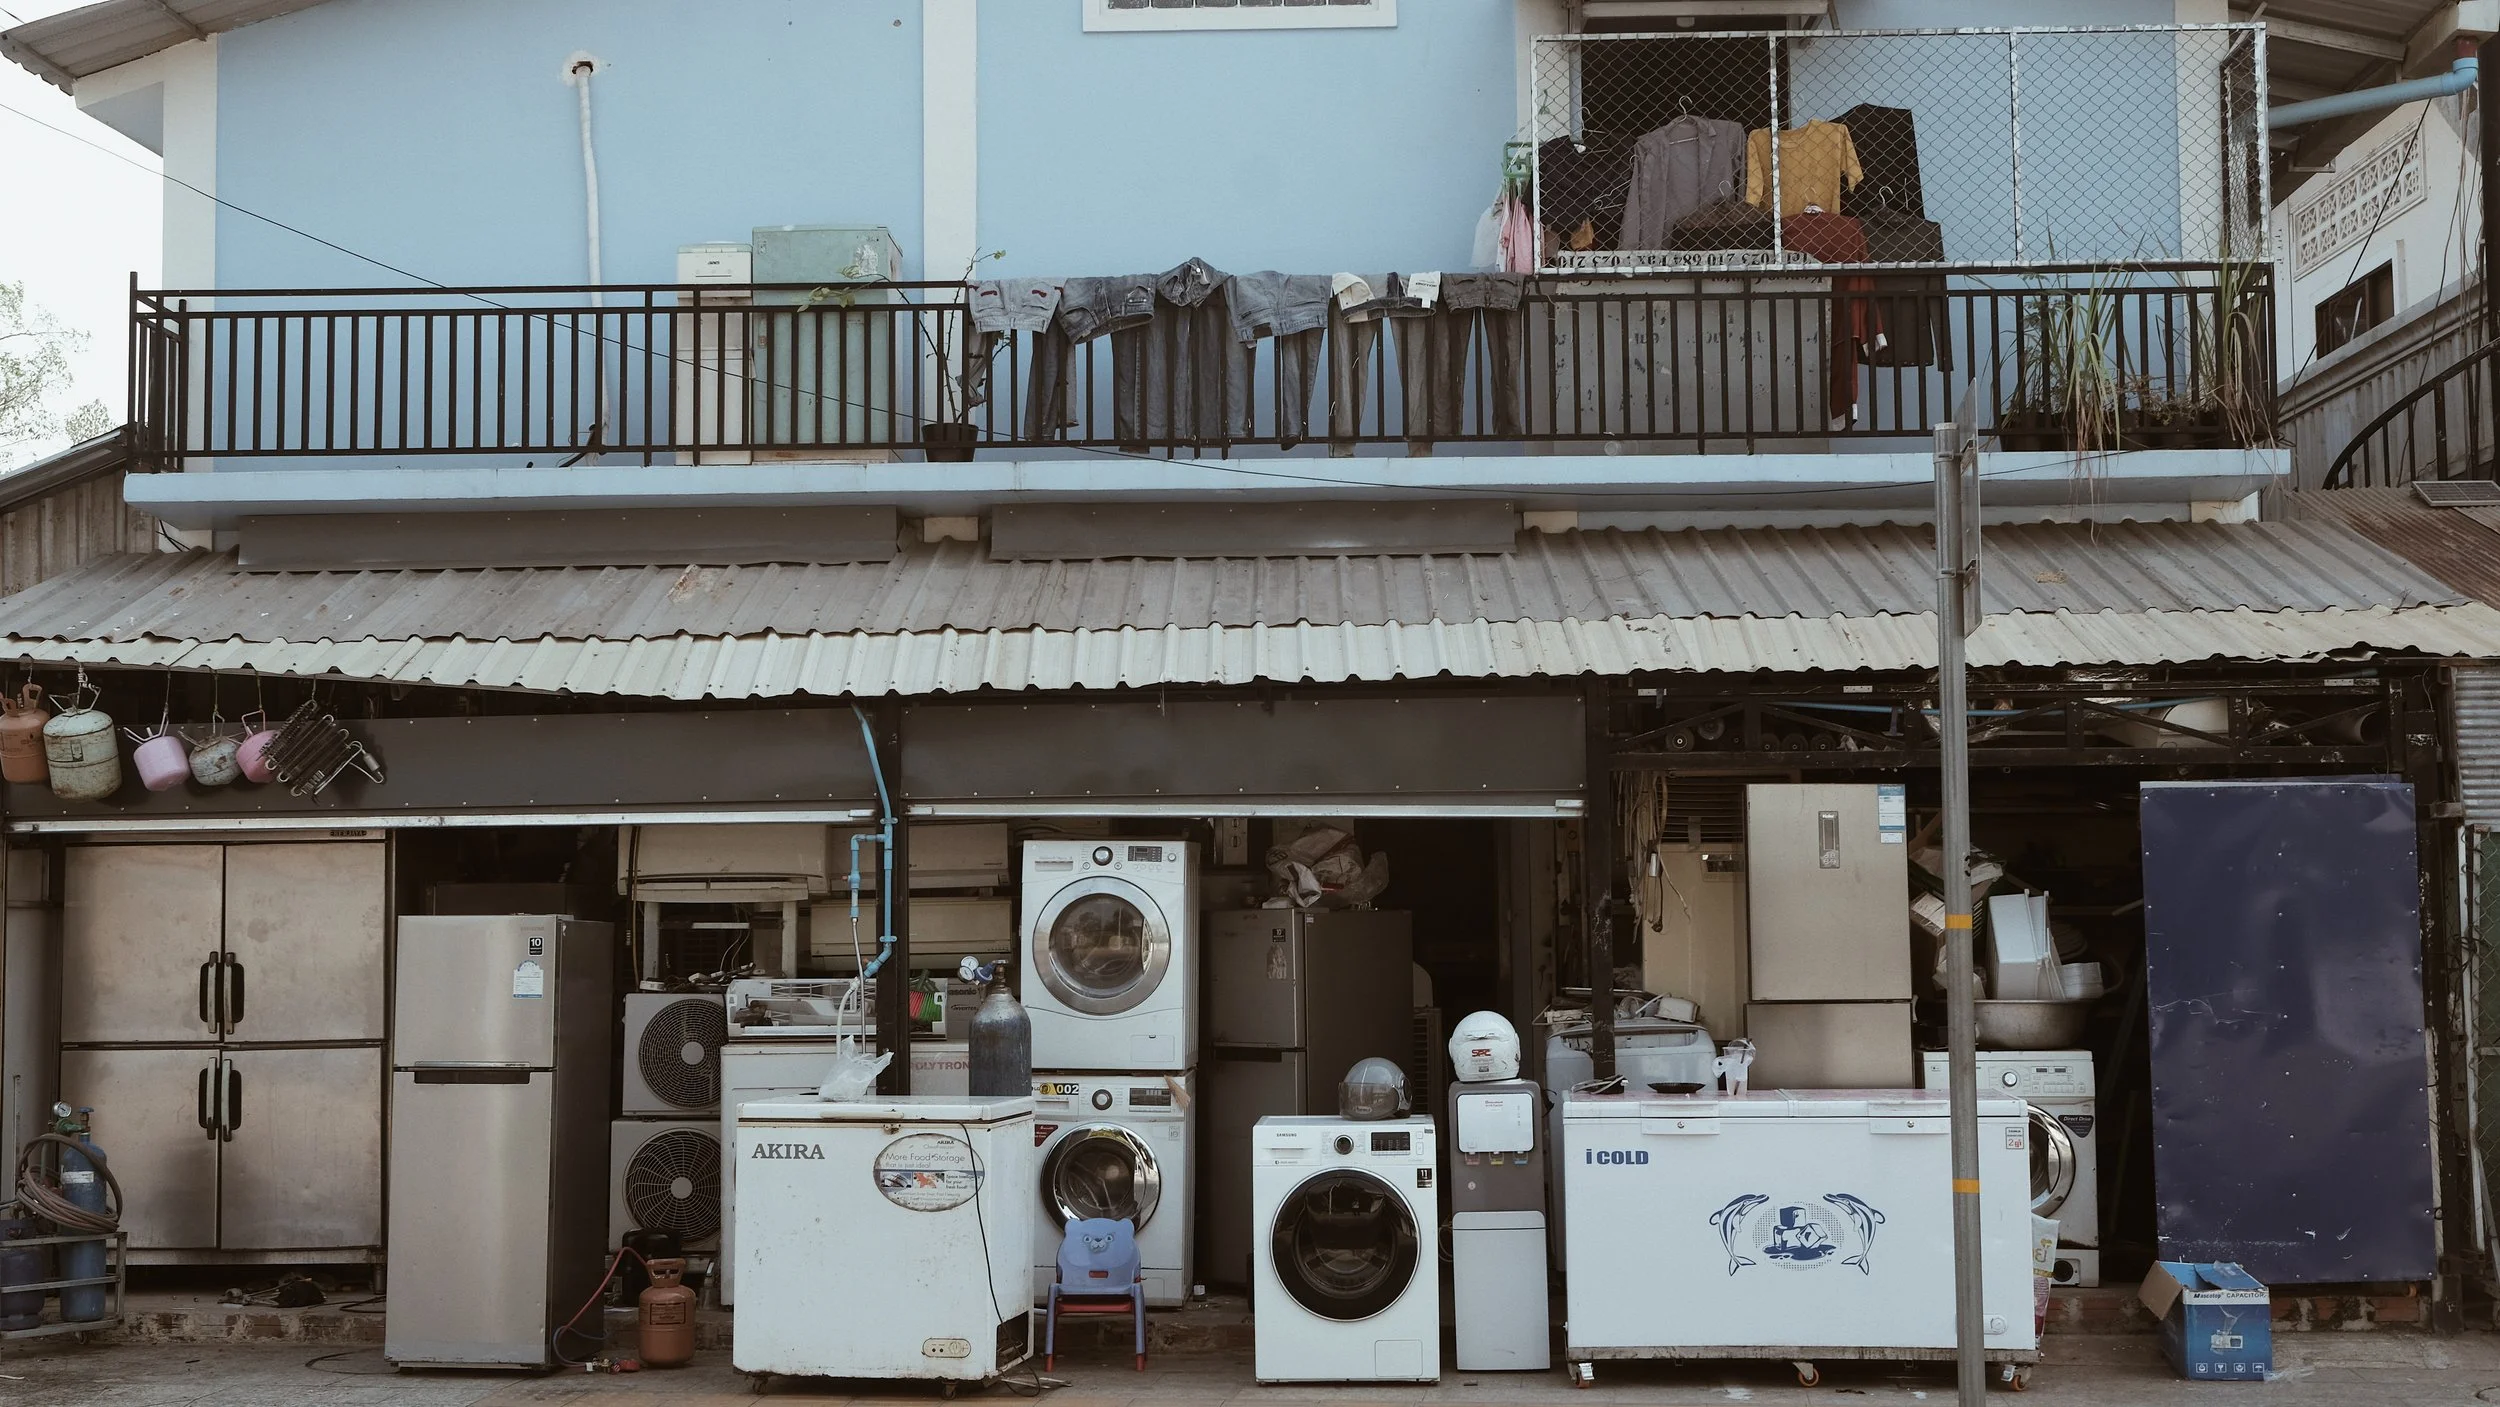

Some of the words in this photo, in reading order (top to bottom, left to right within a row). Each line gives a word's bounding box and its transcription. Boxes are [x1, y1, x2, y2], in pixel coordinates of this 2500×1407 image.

[1592, 255, 1621, 268] 023
[1707, 252, 1736, 266] 210
[1741, 252, 1770, 266] 023
[530, 938, 542, 947] 10
[911, 1061, 969, 1070] OLYTRON
[1056, 1084, 1079, 1094] 002
[751, 1143, 825, 1160] AKIRA
[885, 1153, 908, 1161] More
[910, 1153, 931, 1161] Food
[933, 1153, 966, 1164] Storage
